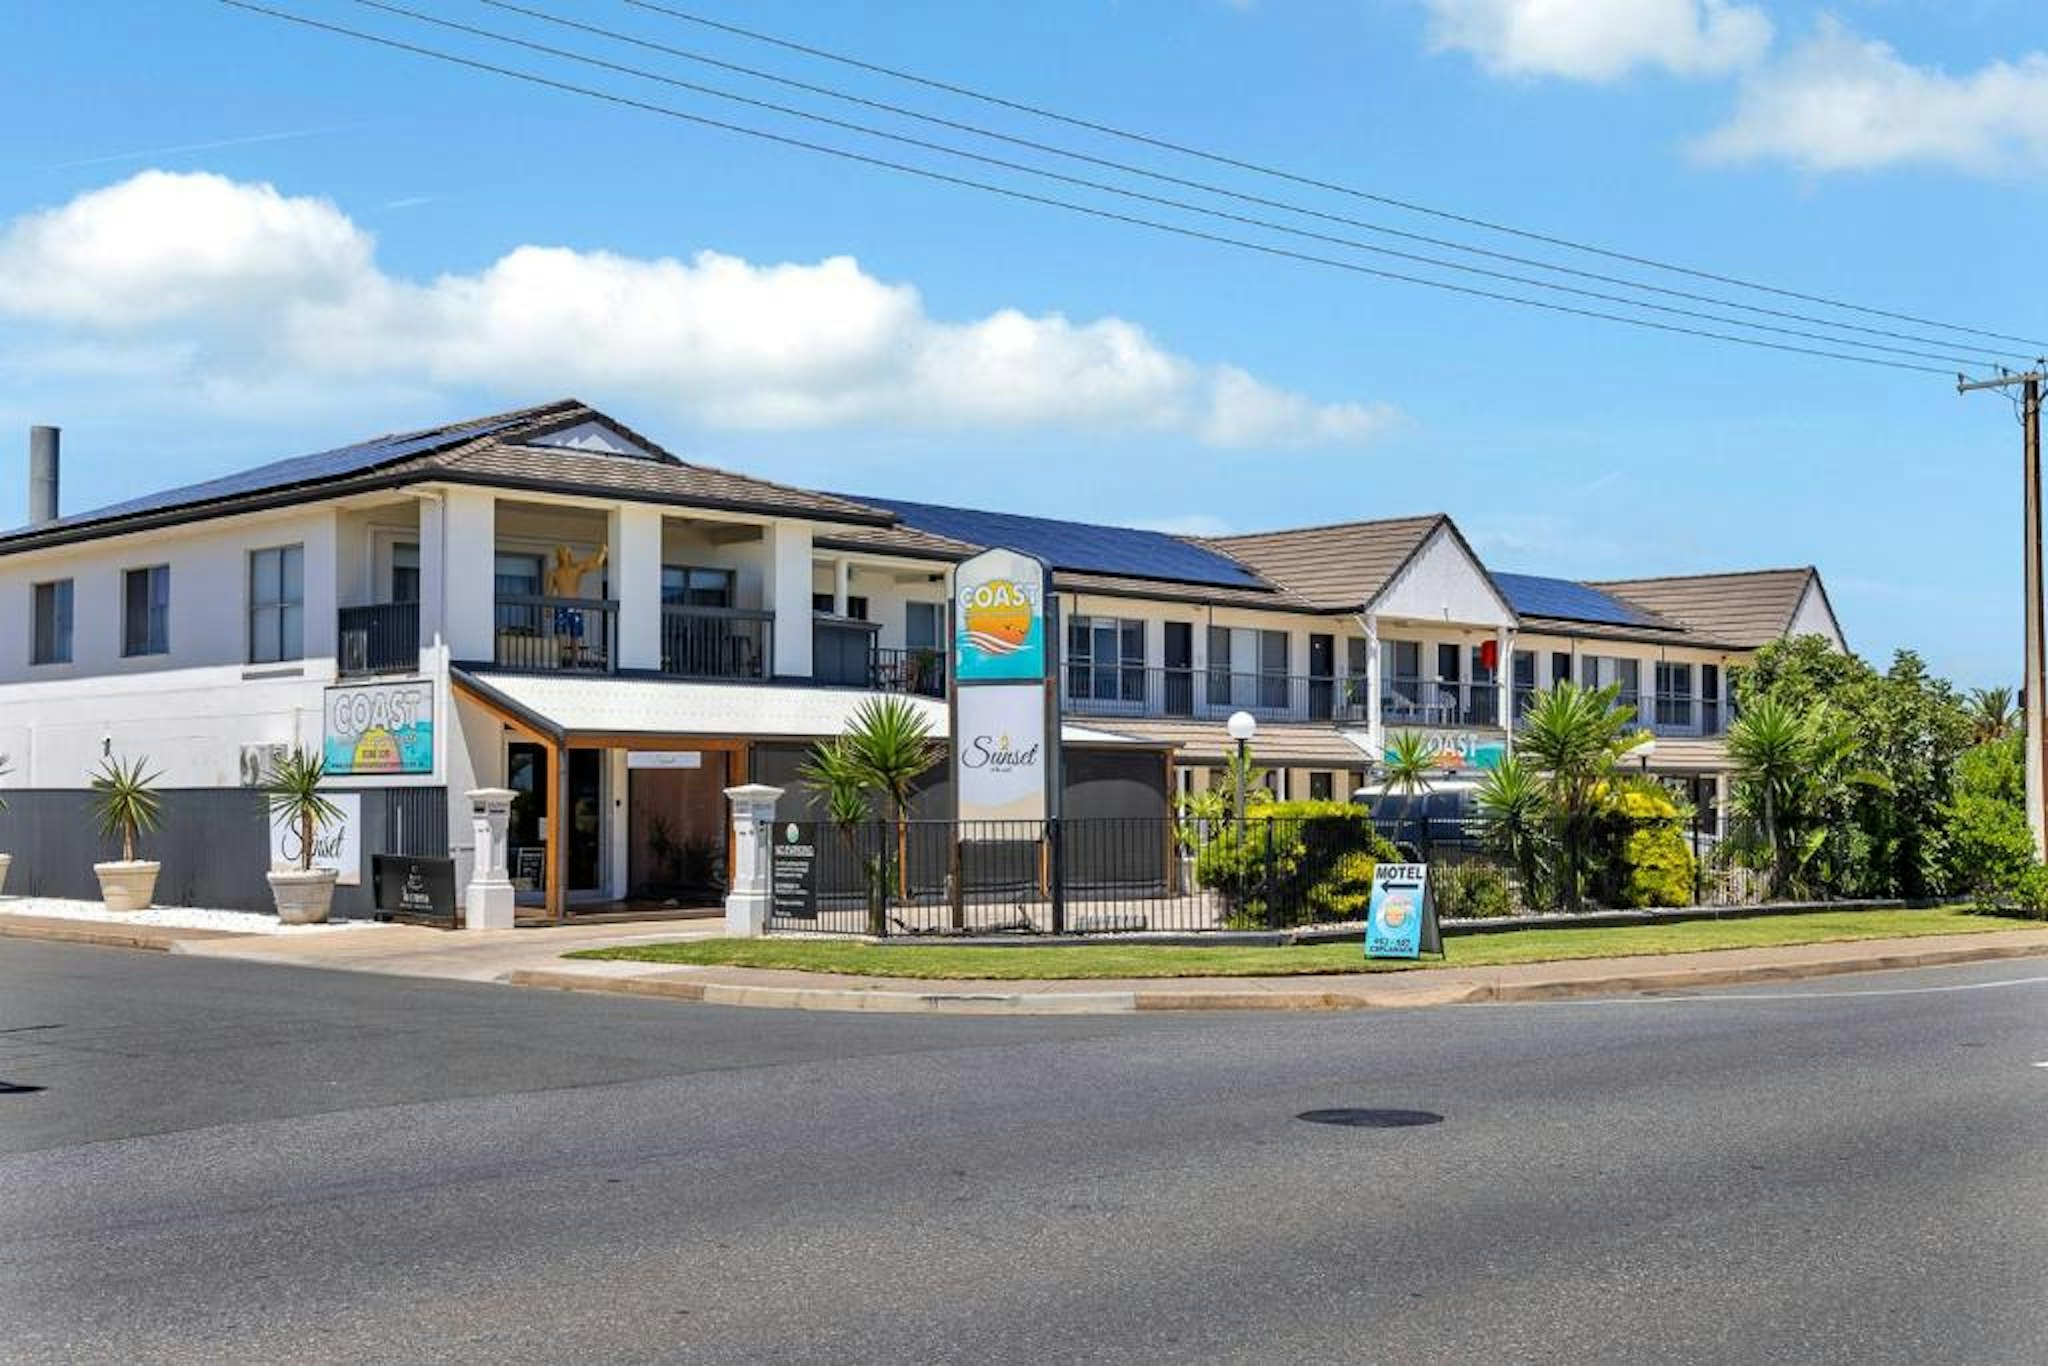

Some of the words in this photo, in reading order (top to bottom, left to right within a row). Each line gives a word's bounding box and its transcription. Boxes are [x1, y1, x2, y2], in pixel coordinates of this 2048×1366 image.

[960, 582, 1039, 609] COAST
[334, 690, 421, 735] COAST
[961, 735, 1039, 769] Sunset
[1417, 731, 1478, 759] OAST
[1376, 866, 1423, 880] MOTEL
